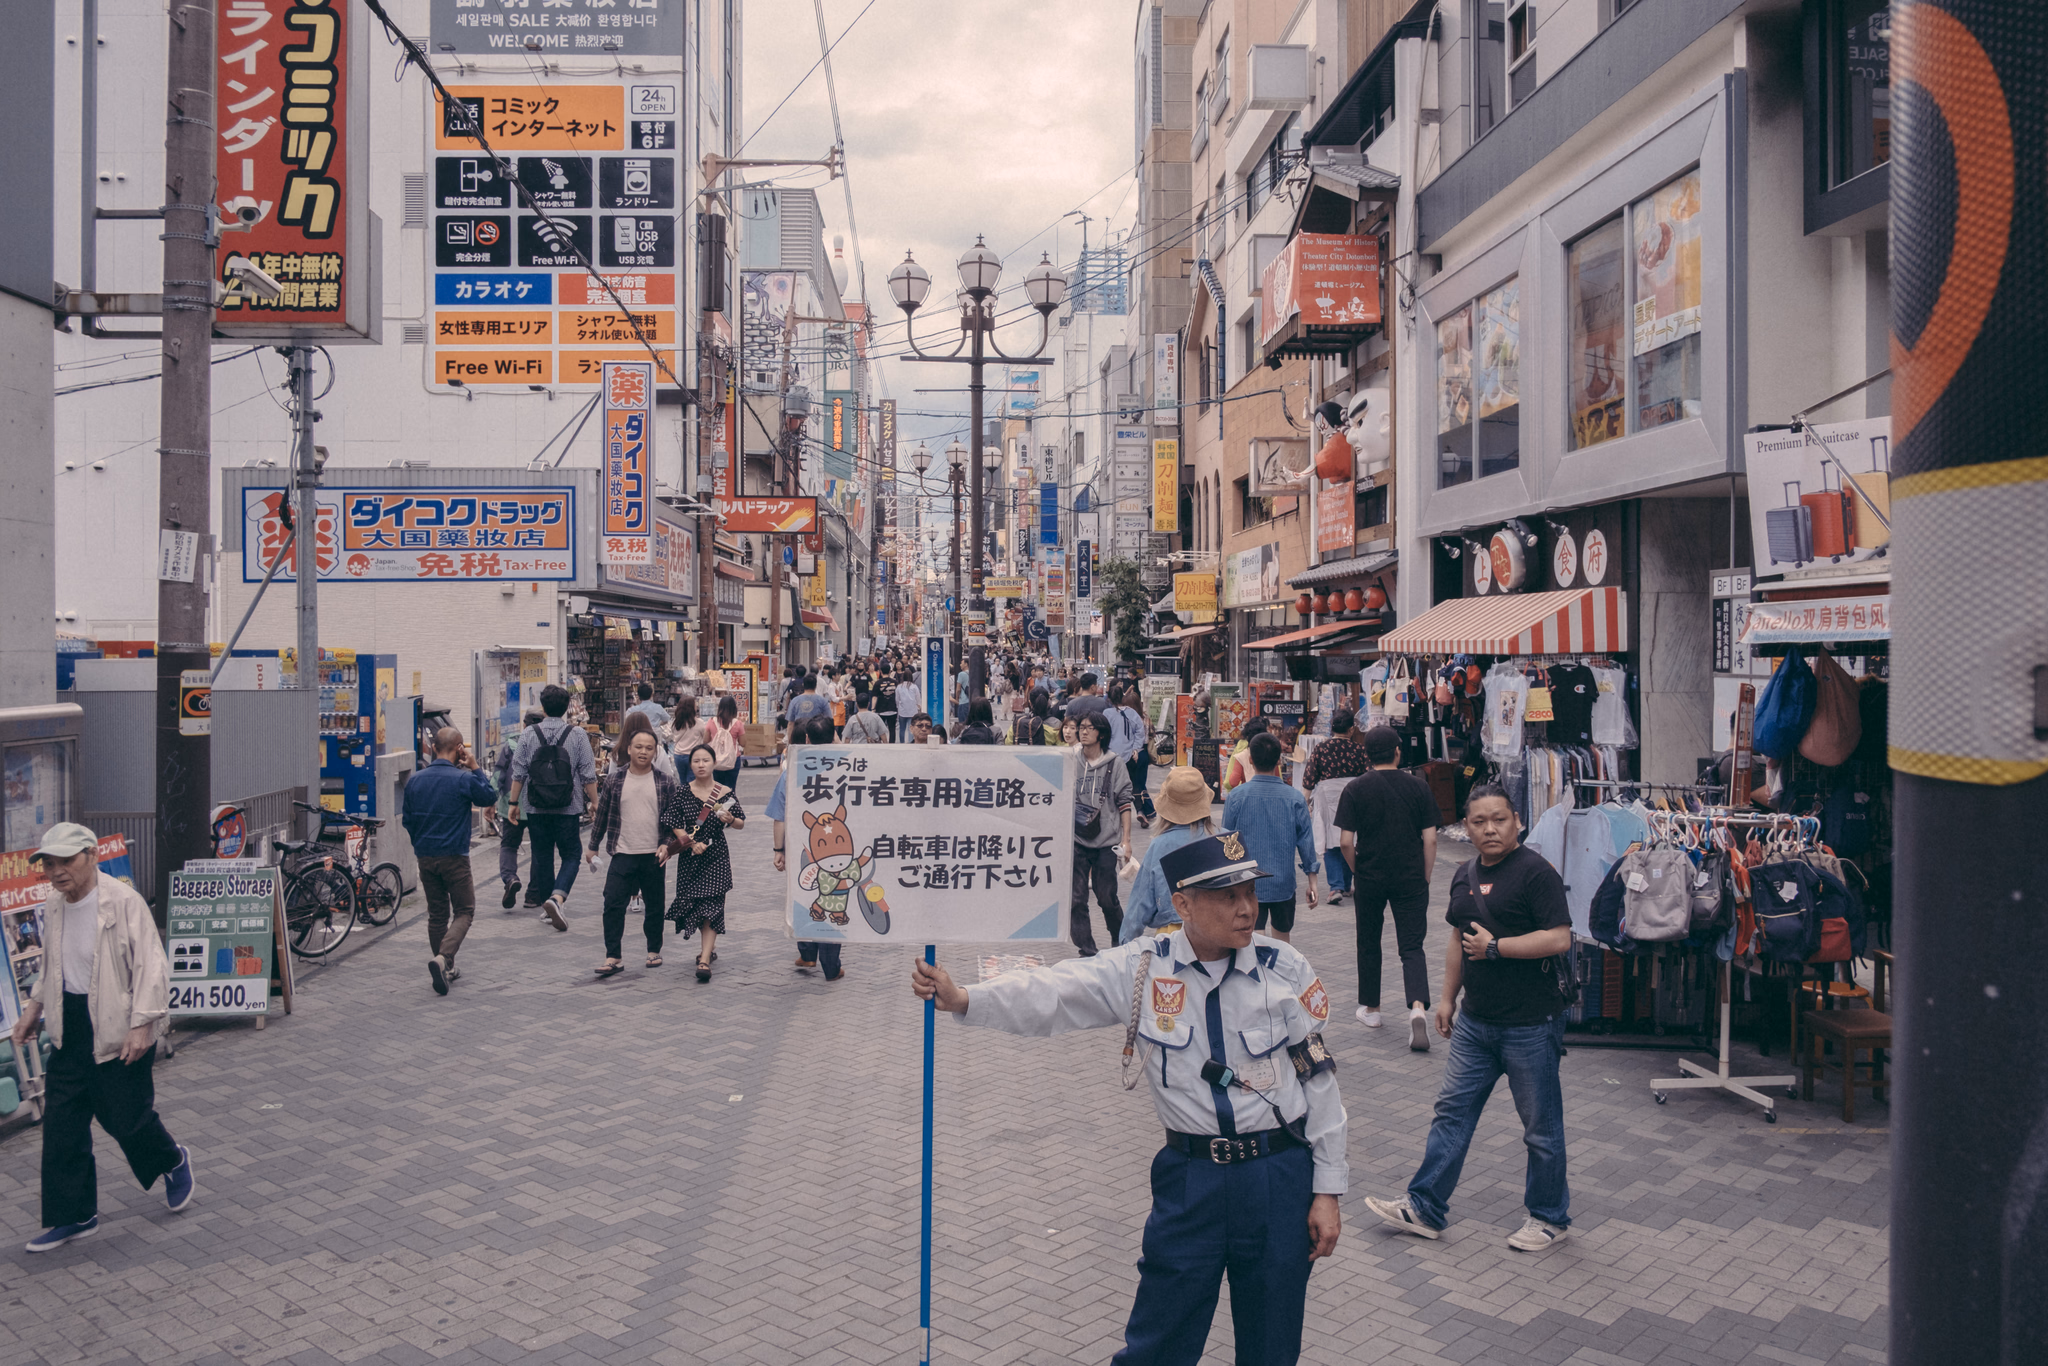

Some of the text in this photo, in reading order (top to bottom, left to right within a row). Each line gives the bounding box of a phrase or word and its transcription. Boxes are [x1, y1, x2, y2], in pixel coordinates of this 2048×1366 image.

[456, 14, 658, 27] 세일판매 SALE 大减价 환영합니다
[488, 34, 569, 48] WELCOME
[641, 89, 665, 103] 24h
[491, 98, 560, 115] コミック
[641, 104, 666, 112] OPEN
[492, 119, 616, 137] インターネット
[640, 122, 666, 133] 受付
[642, 136, 665, 148] 6F
[444, 197, 502, 206] 鍵付き完全個室
[534, 192, 576, 201] シャワー無料
[616, 198, 658, 206] ランドリー
[636, 231, 659, 242] USB
[1316, 238, 1343, 246] Museum
[1354, 239, 1377, 247] History
[639, 242, 656, 252] OK
[456, 253, 490, 262] 完全分煙
[532, 256, 578, 265] Free Wi-Fi
[619, 255, 654, 265] USB 充電
[1302, 252, 1328, 260] Theater
[1329, 253, 1344, 261] City
[455, 281, 533, 298] カラオケ
[587, 290, 646, 304] 完全個室
[577, 315, 657, 327] シャワー無料
[439, 321, 548, 336] 女性専用エリア
[577, 329, 657, 341] タオル使い放題
[445, 360, 542, 375] Free Wi-Fi
[828, 362, 849, 370] JRA
[611, 367, 645, 406] 薬
[1640, 401, 1675, 428] OPEN
[1757, 438, 1802, 453] Premium
[1822, 431, 1860, 444] suitcase
[625, 413, 644, 529] ダイコク
[350, 496, 564, 528] ダイコクドラッグ
[1120, 503, 1139, 512] FUN
[606, 537, 648, 554] 免税
[416, 552, 503, 577] 免税
[608, 554, 646, 562] Tax-Free
[504, 559, 567, 572] Tax-Free
[1717, 579, 1727, 592] BF
[1737, 578, 1747, 591] BF
[1528, 709, 1553, 719] 2800
[803, 756, 868, 773] こちらは
[802, 774, 1055, 809] 歩行者専用道路です
[872, 834, 1054, 861] 自転車は降りて
[898, 863, 1053, 890] ご通行下さい
[172, 875, 273, 899] Baggage Storage
[211, 920, 228, 929] 安全
[169, 984, 266, 1010] 24h 500 yen
[1155, 1005, 1180, 1014] KANSAI
